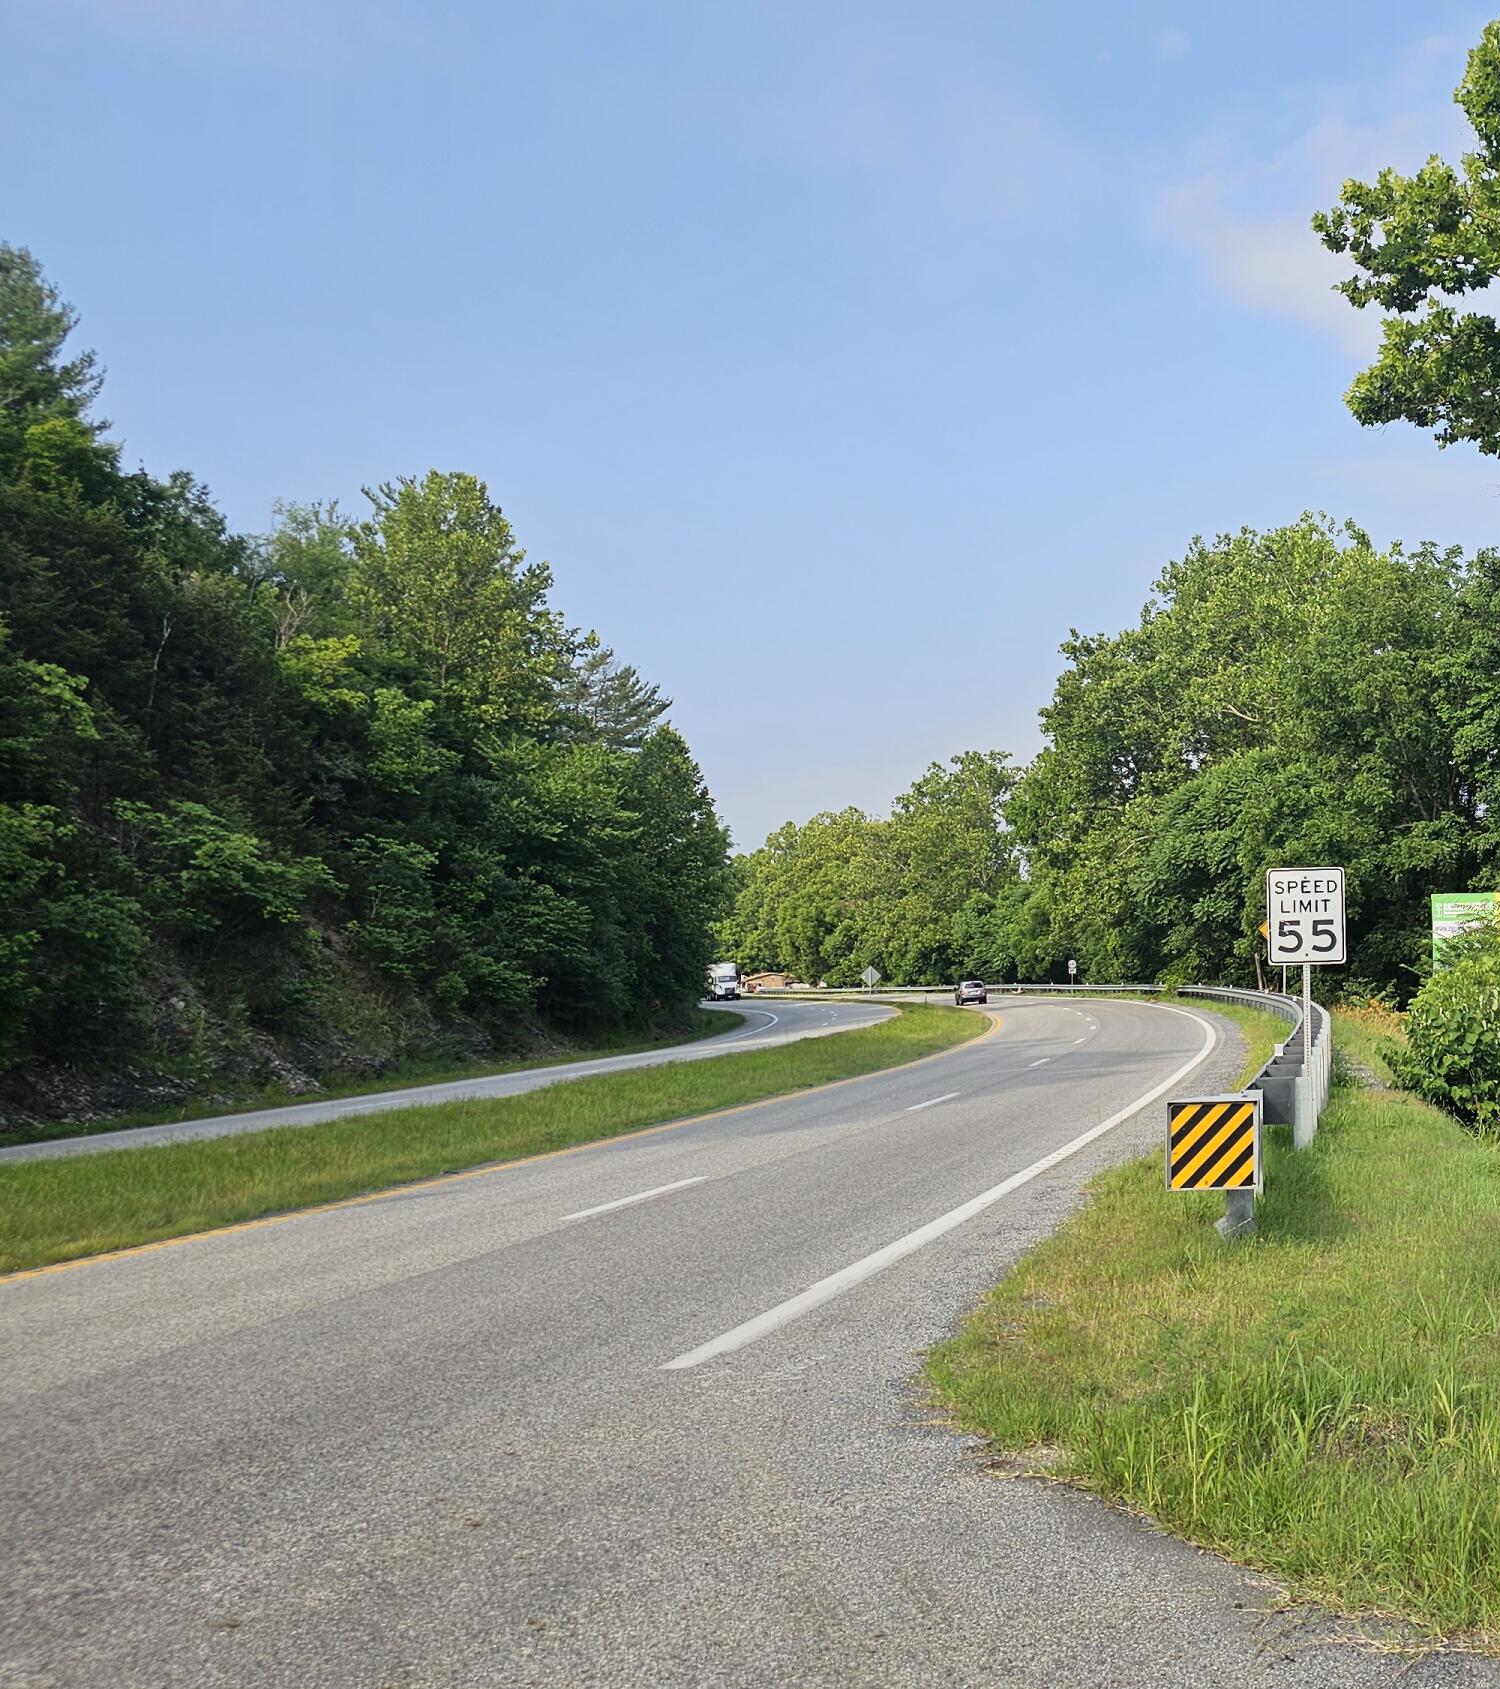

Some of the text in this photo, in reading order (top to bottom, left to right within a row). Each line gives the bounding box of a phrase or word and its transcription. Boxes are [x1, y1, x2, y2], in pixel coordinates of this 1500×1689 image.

[1274, 880, 1338, 895] SPEED
[1280, 898, 1331, 913] LIMIT
[1277, 919, 1337, 953] 55
